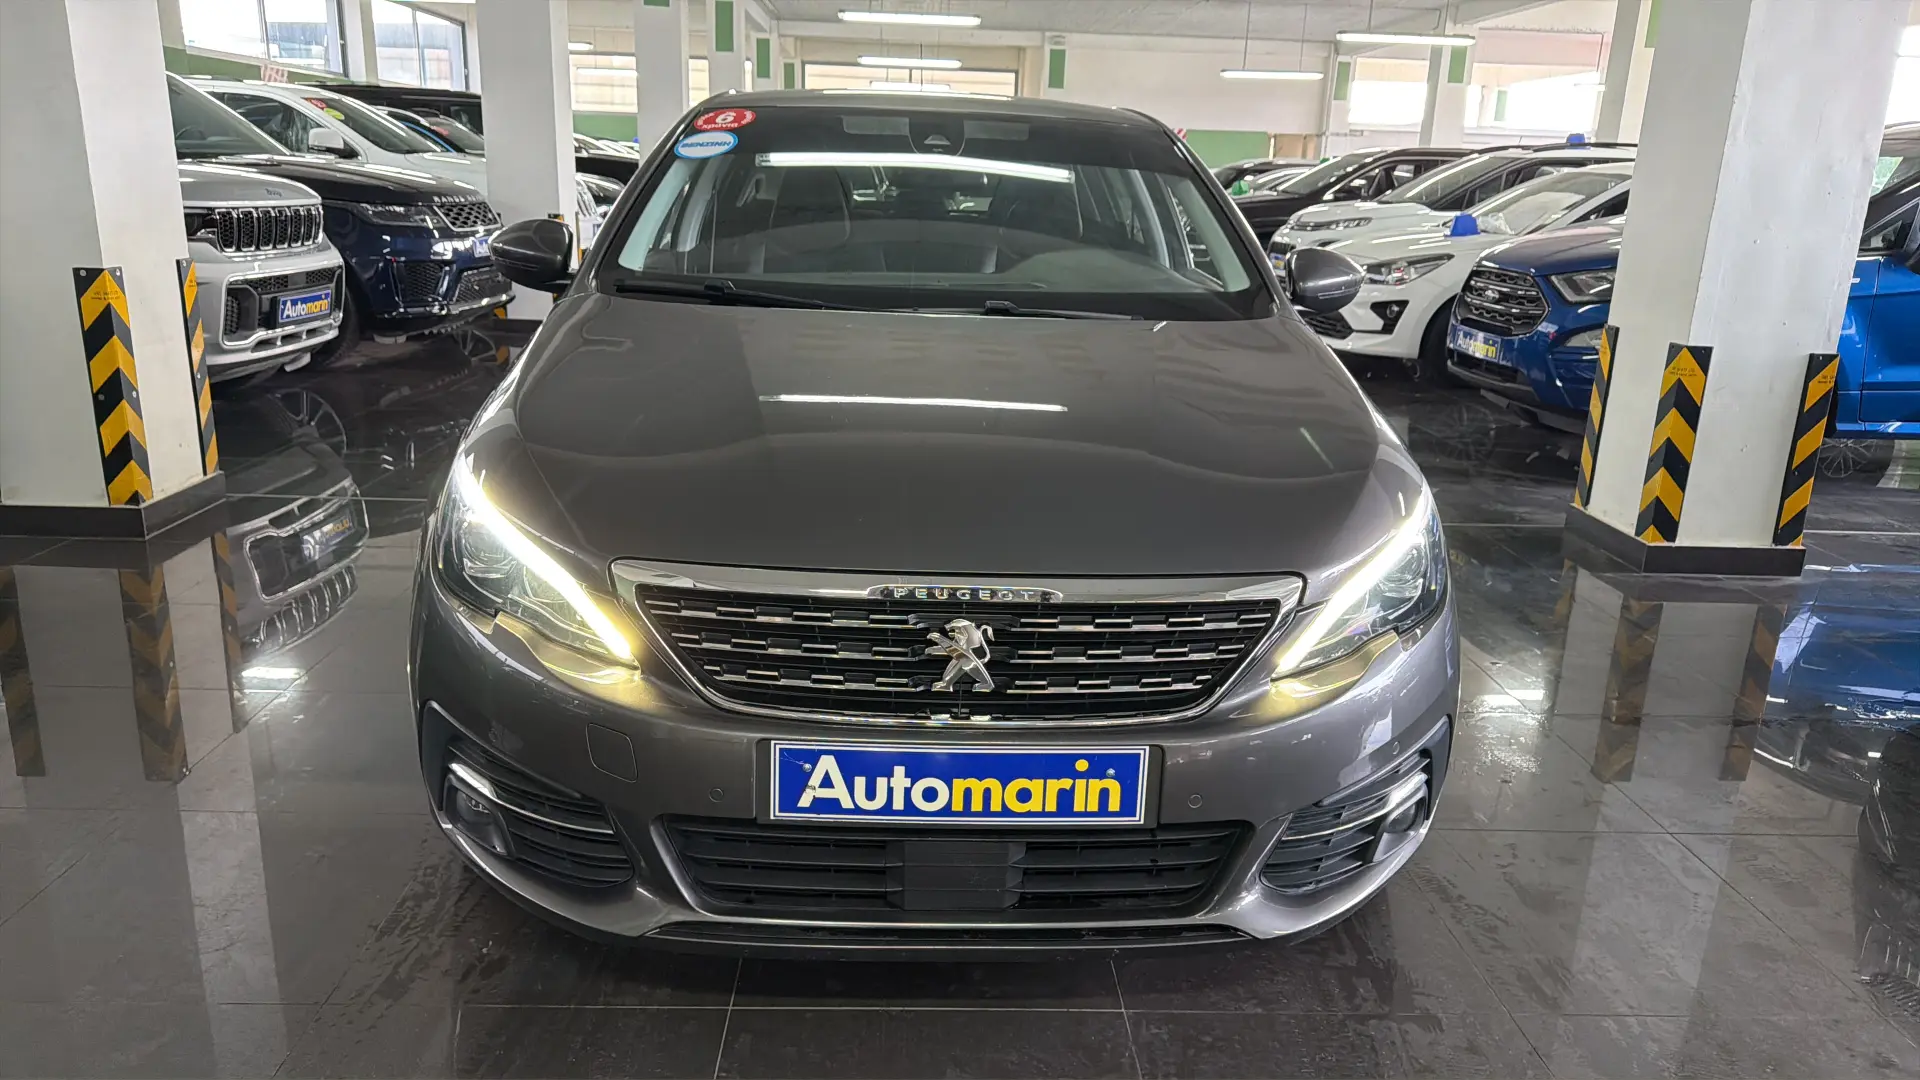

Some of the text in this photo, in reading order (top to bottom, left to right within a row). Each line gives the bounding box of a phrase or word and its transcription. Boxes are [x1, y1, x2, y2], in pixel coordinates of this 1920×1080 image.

[715, 111, 737, 124] 6
[282, 294, 329, 319] Automarin
[893, 586, 1034, 602] PEUGEOT
[796, 754, 1121, 813] Automarin
